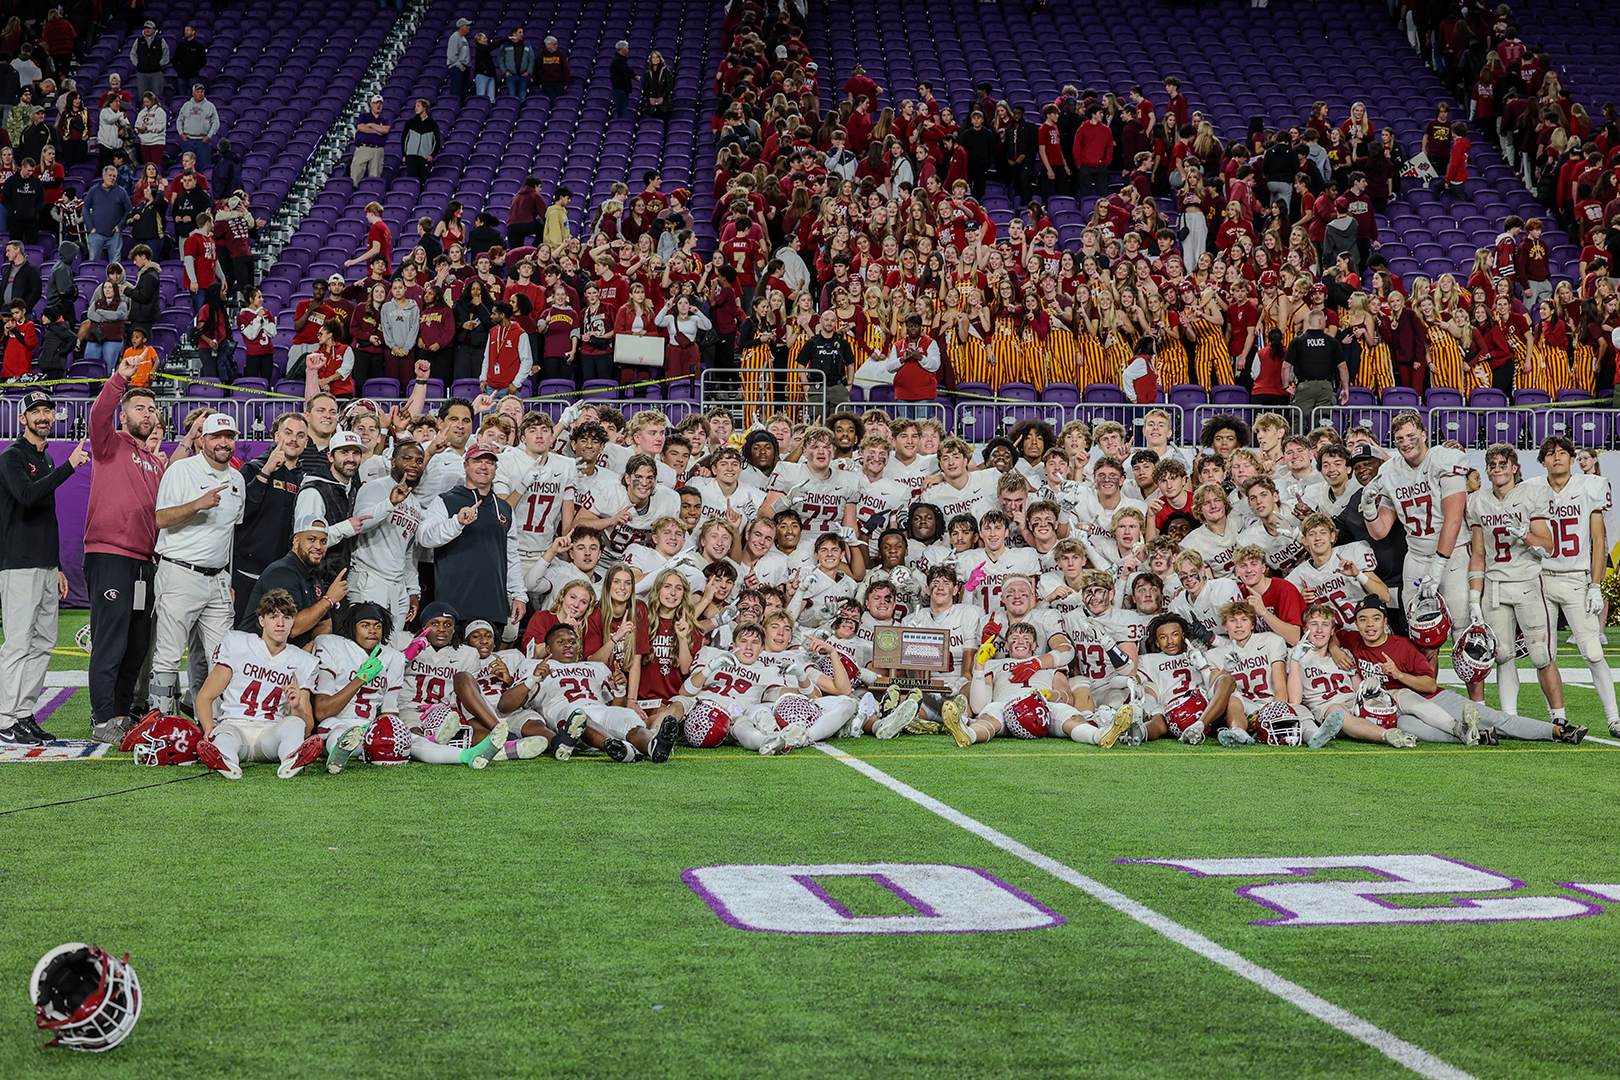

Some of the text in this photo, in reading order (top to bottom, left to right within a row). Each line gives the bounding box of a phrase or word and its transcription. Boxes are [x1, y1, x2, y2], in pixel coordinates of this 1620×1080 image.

[733, 252, 746, 273] 7
[1307, 338, 1326, 347] POLICE
[858, 493, 886, 510] MSON
[1554, 504, 1581, 518] MSON
[390, 513, 418, 532] FOOTBA
[522, 494, 555, 533] 17
[802, 503, 839, 531] 77
[1400, 494, 1436, 536] 57
[1480, 511, 1523, 528] CRIMSN
[1492, 527, 1512, 562] 6
[1127, 624, 1143, 639] 33
[411, 660, 458, 679] CRIMSON
[1076, 644, 1107, 679] 33
[243, 663, 294, 687] CRIMSON
[349, 670, 389, 690] CMSON
[550, 667, 596, 679] CRIMSON
[889, 678, 932, 686] FOOTBALL
[1172, 668, 1192, 695] 3
[240, 680, 284, 720] 44
[412, 675, 446, 705] 18
[559, 678, 598, 704] 21
[354, 687, 379, 719] 5
